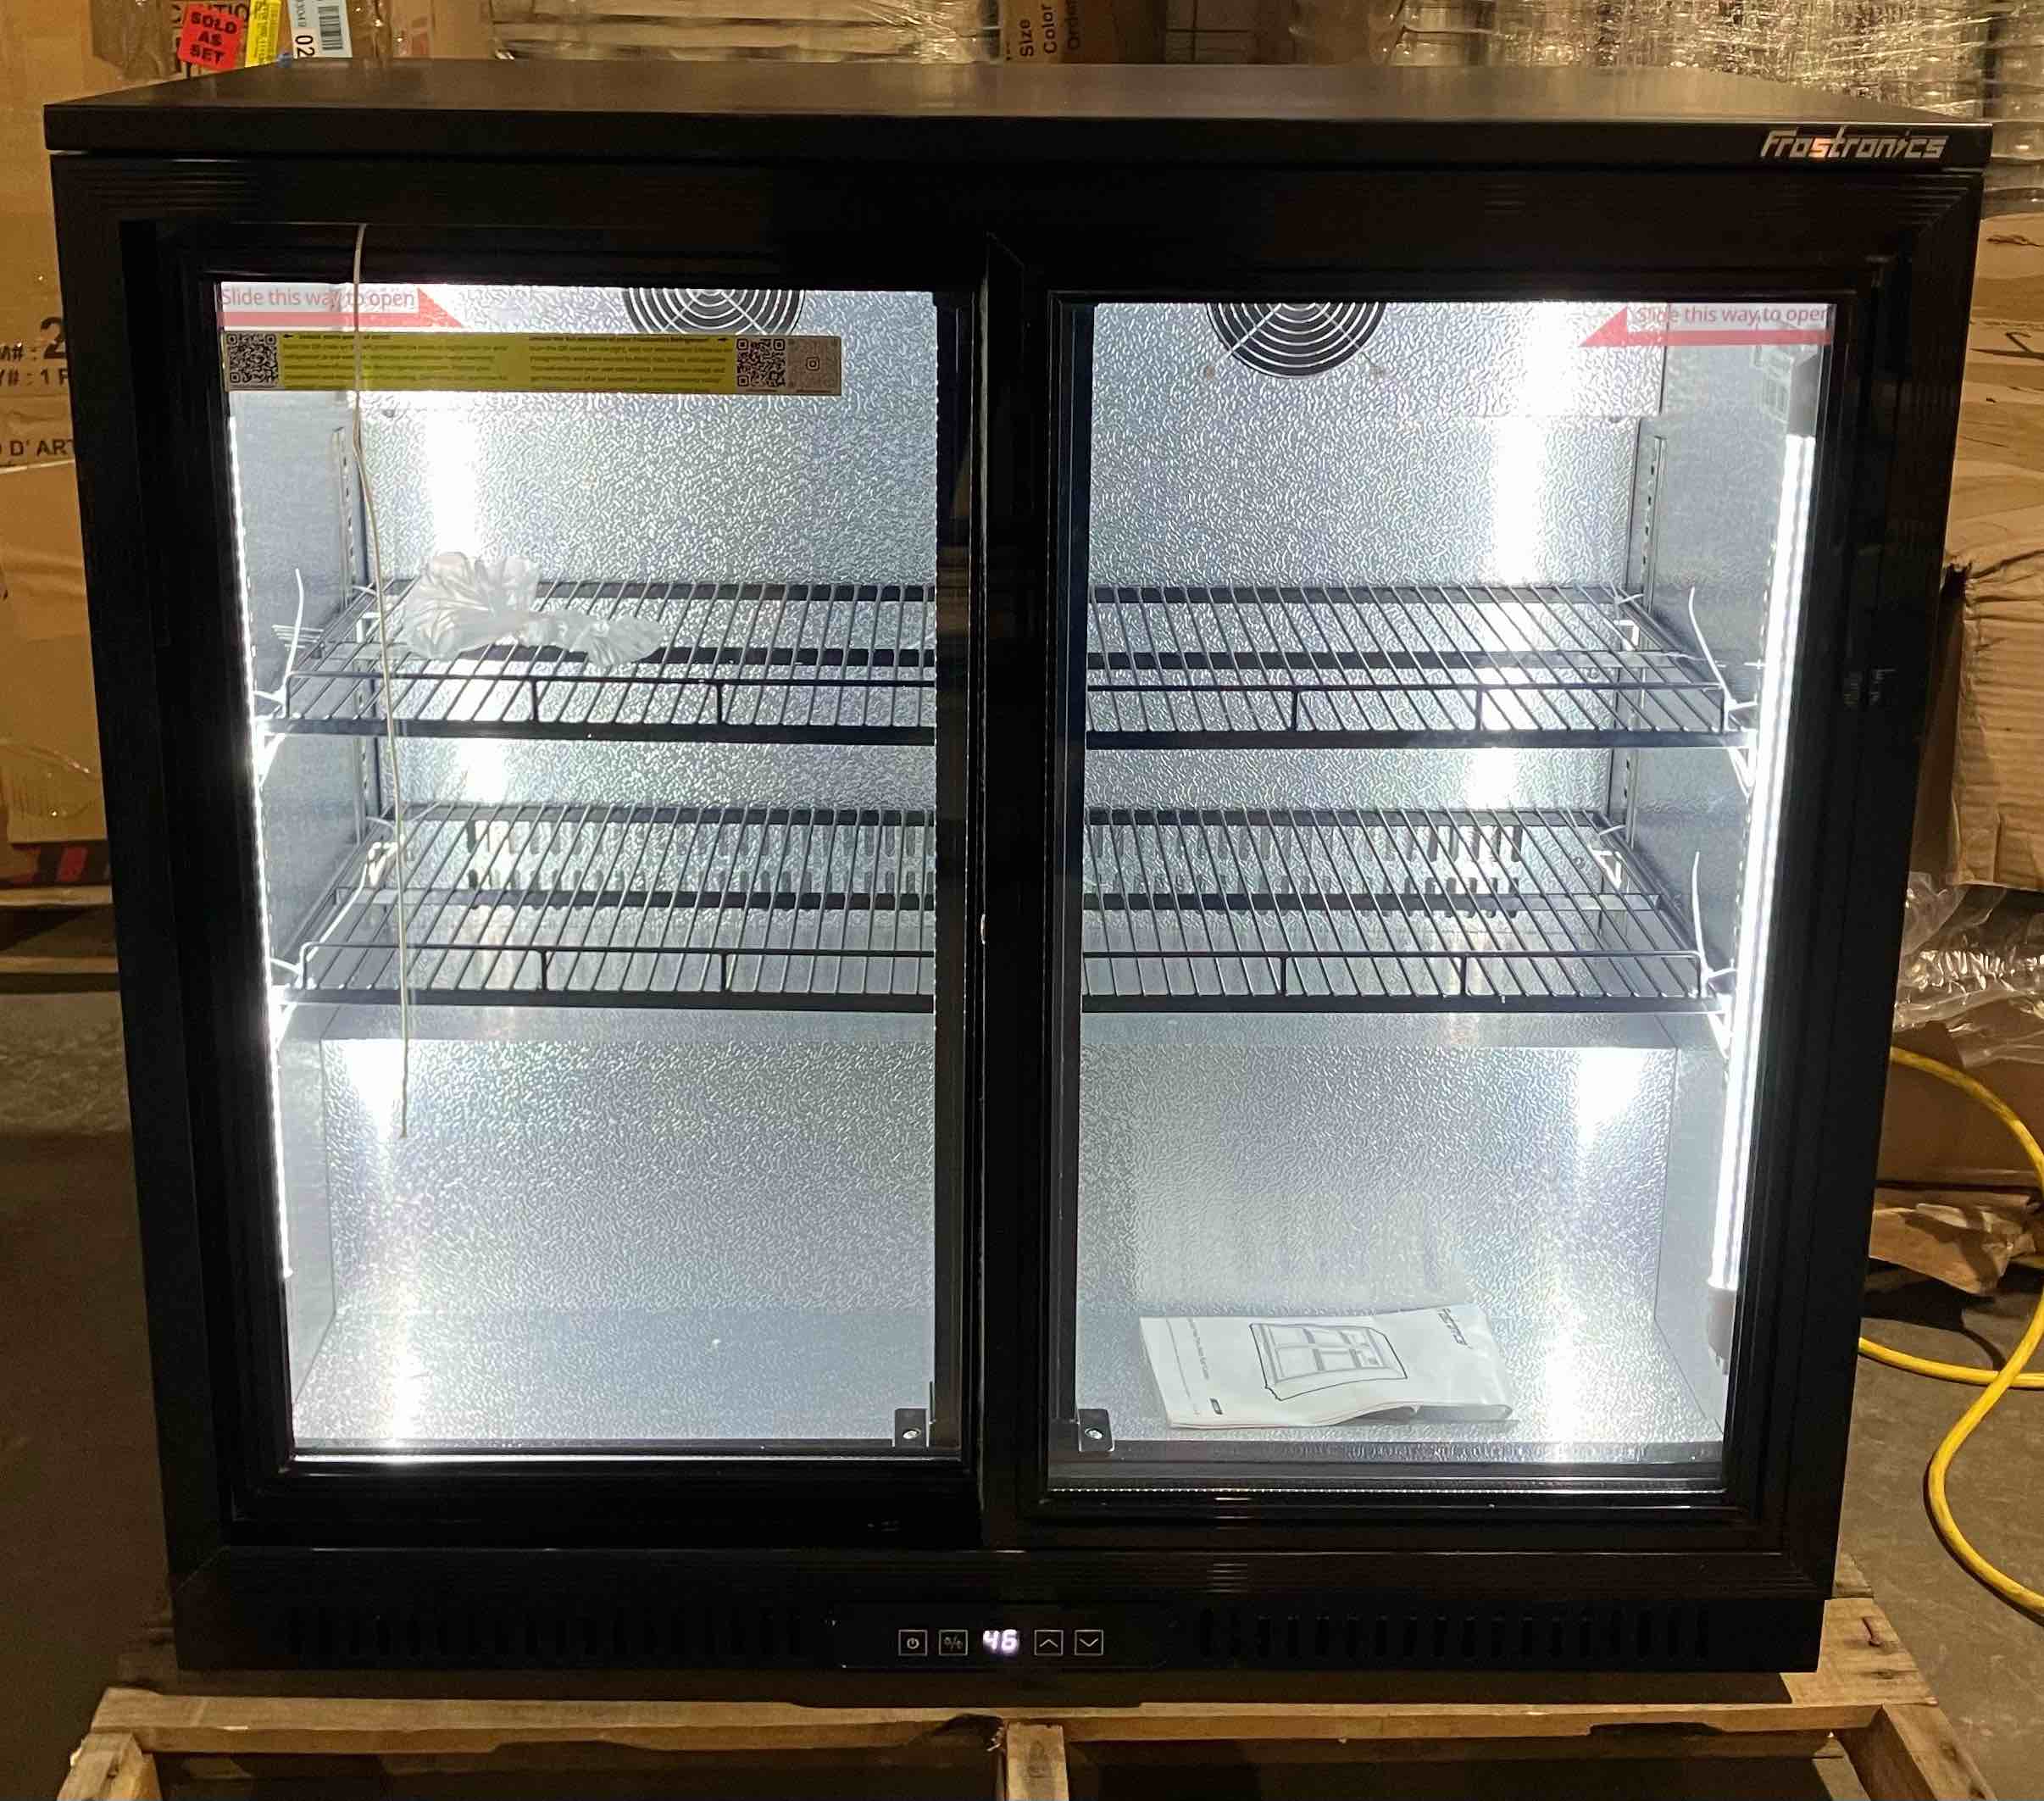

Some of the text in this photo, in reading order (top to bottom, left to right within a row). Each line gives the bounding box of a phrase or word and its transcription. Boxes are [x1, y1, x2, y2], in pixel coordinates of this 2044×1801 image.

[191, 11, 237, 34] SOLD
[1041, 3, 1058, 53] Color
[197, 31, 223, 47] AS
[1019, 19, 1034, 57] Size
[190, 43, 225, 64] SET
[222, 287, 267, 306] Slide
[270, 287, 302, 306] this
[306, 291, 340, 309] way
[369, 292, 414, 310] open
[1639, 306, 1680, 324] Slide
[1685, 305, 1717, 323] this
[1721, 308, 1758, 325] way
[1763, 306, 1781, 322] to
[983, 1629, 1019, 1654] 46
